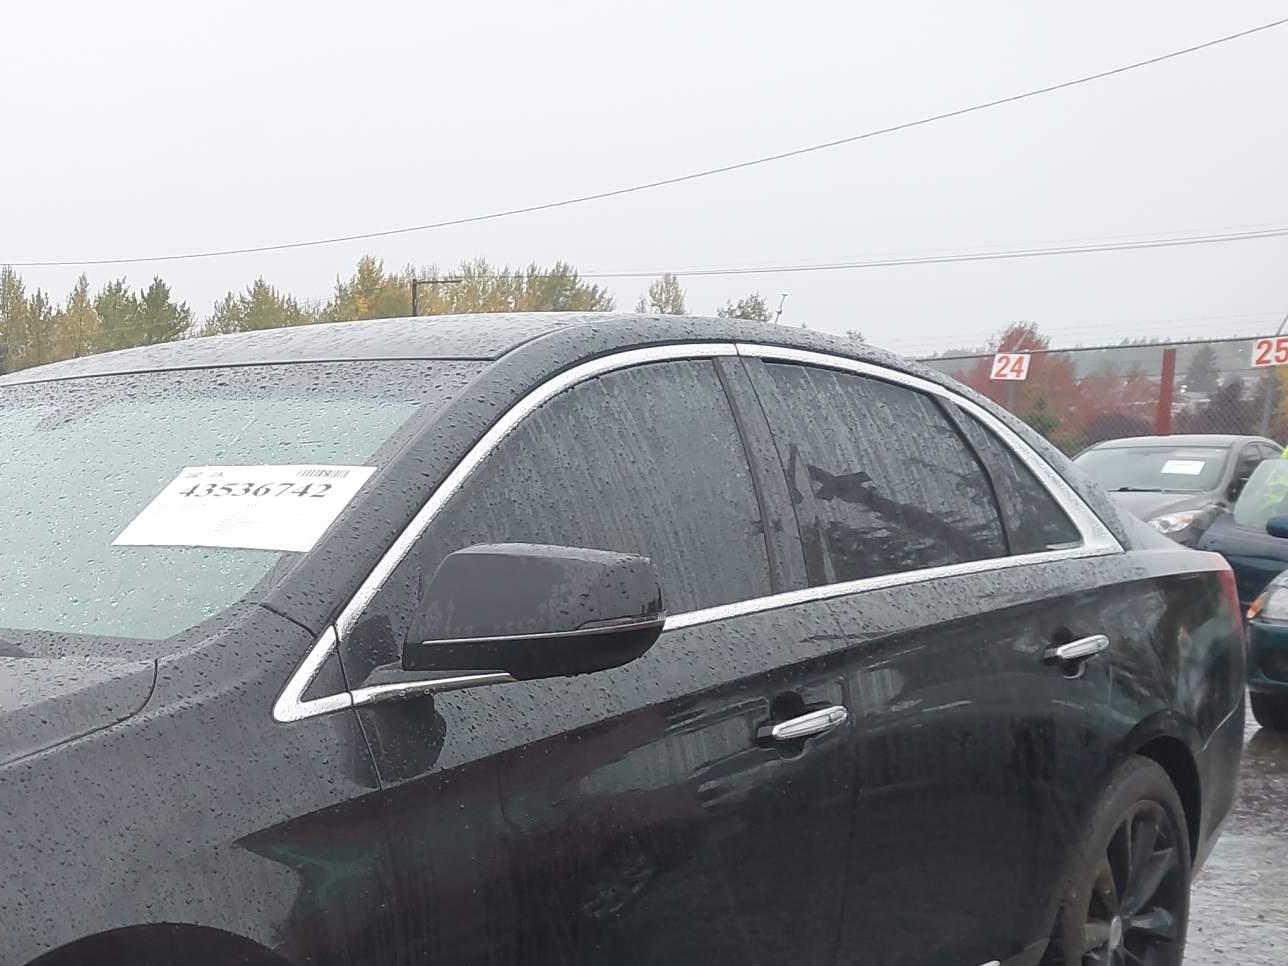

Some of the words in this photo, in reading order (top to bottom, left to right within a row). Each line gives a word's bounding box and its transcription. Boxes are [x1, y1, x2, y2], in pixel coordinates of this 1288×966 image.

[1255, 338, 1288, 365] 25
[993, 355, 1026, 378] 24
[179, 482, 332, 498] 43536742
